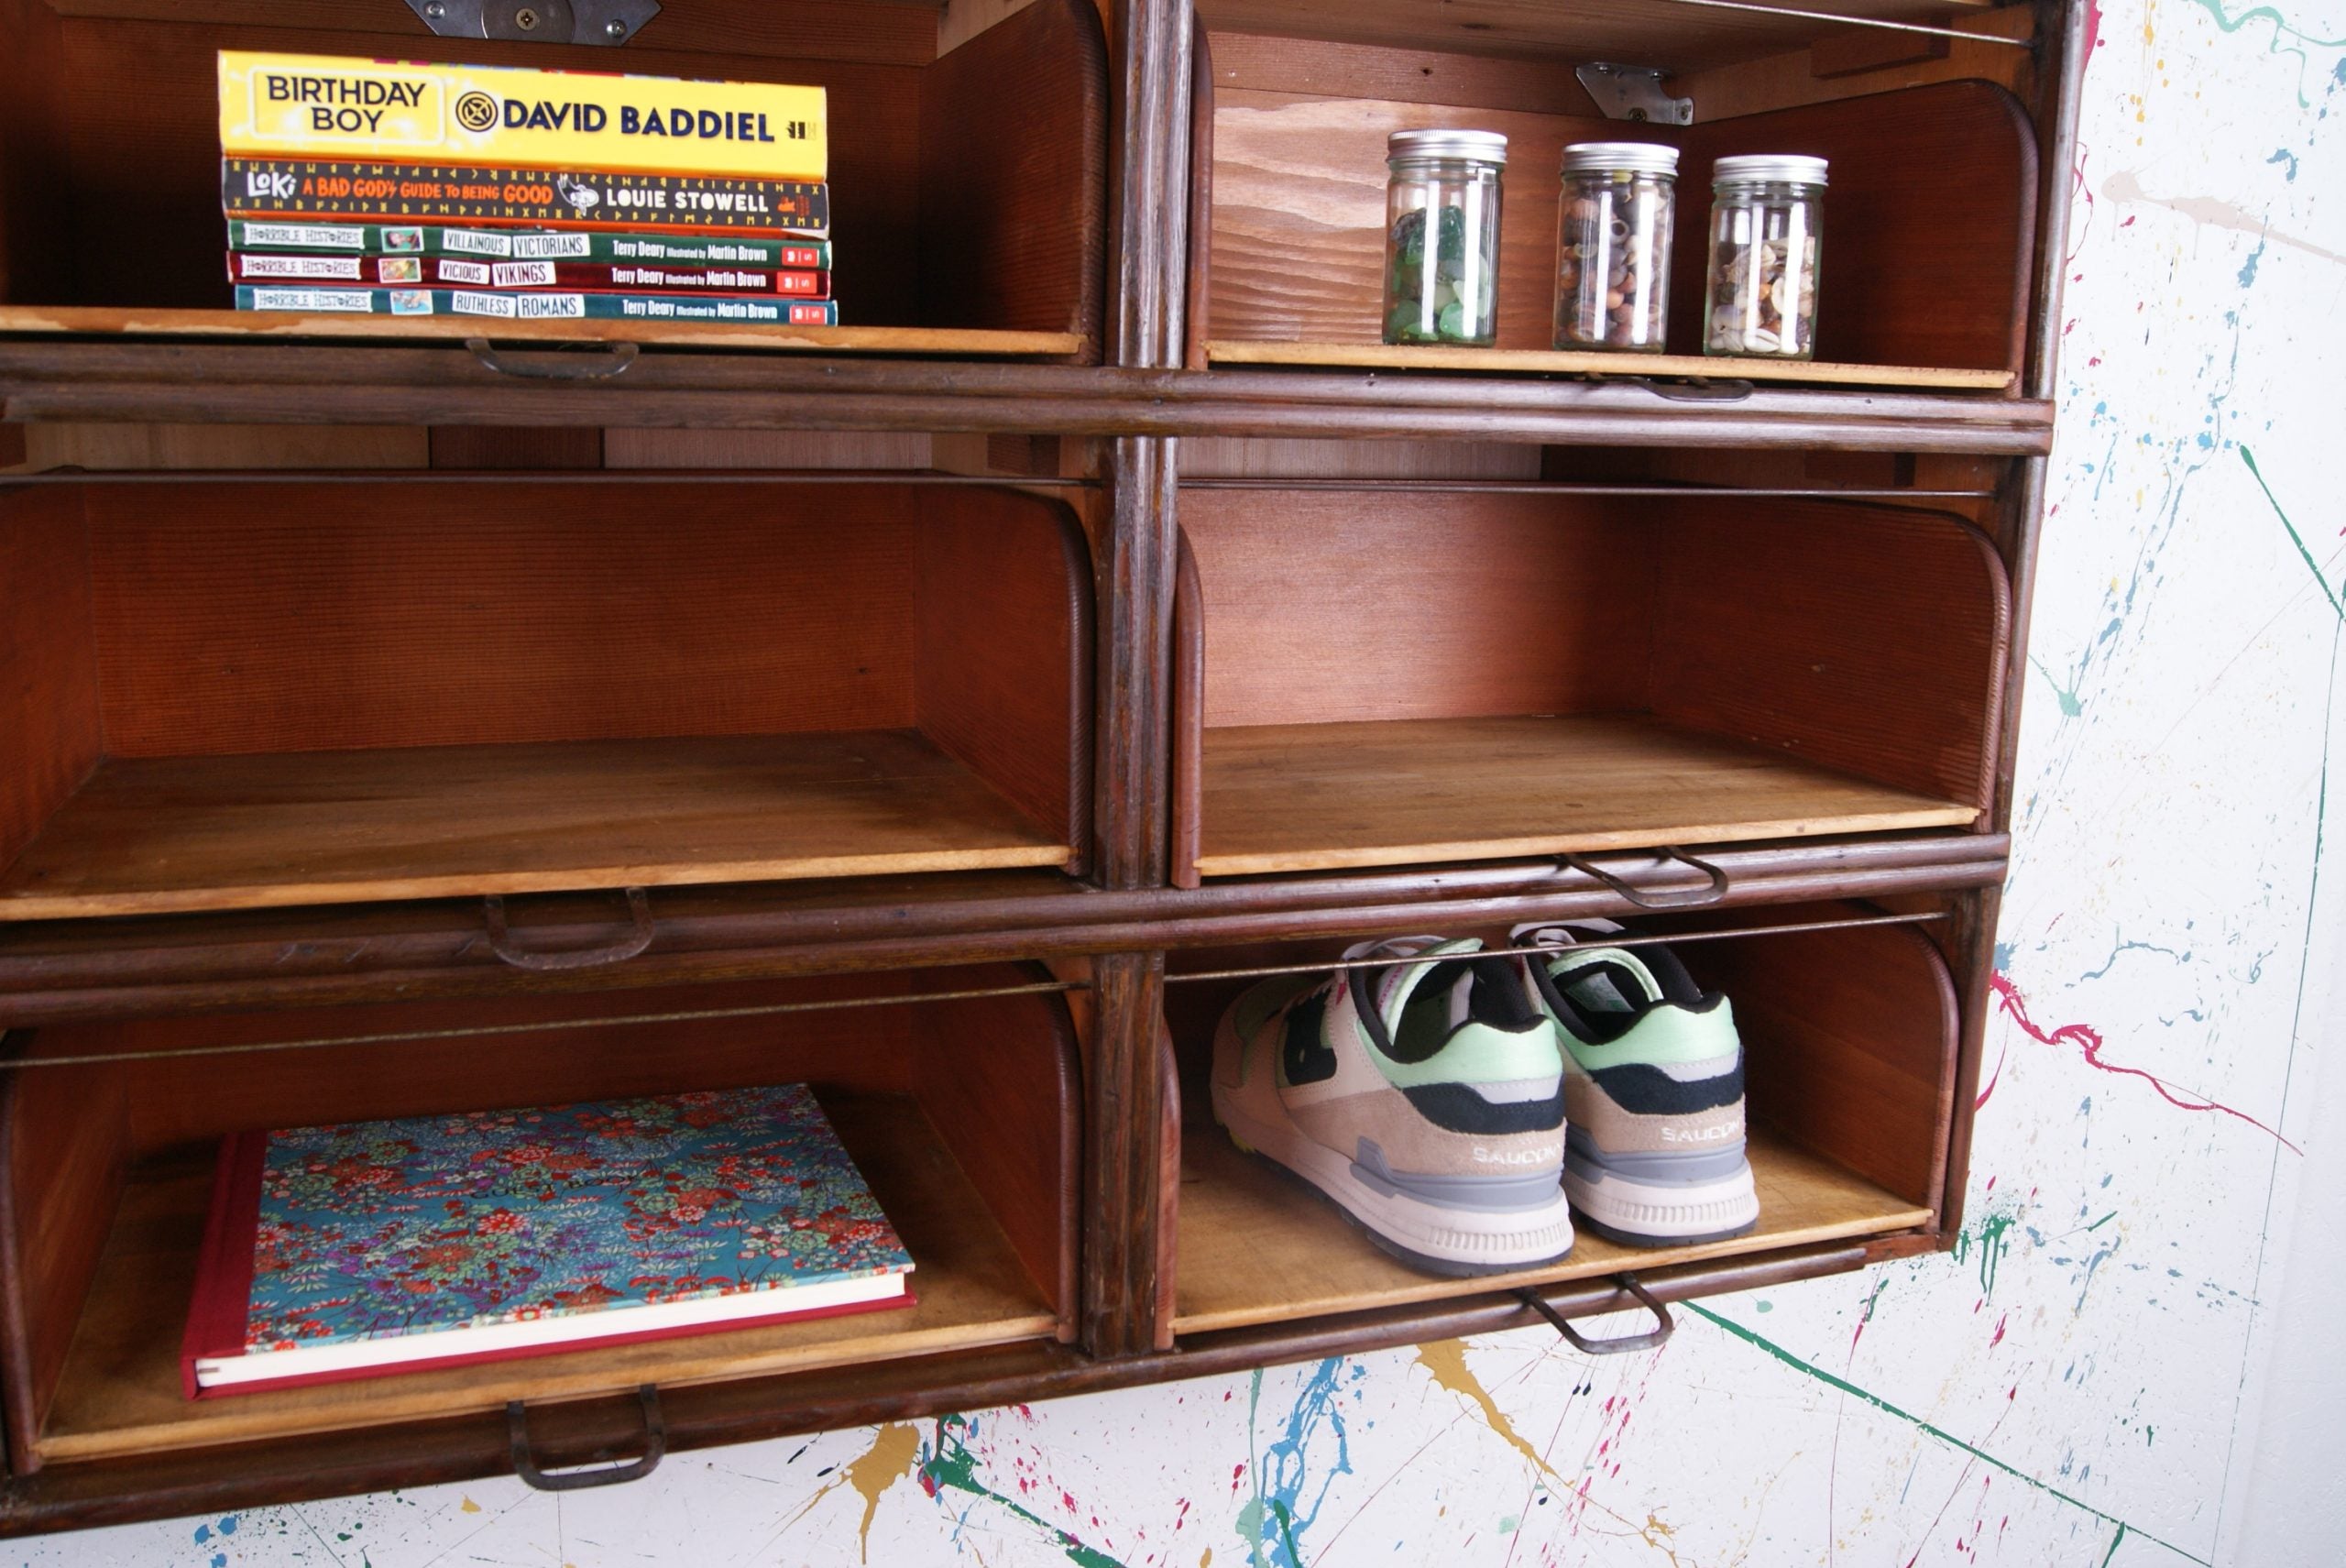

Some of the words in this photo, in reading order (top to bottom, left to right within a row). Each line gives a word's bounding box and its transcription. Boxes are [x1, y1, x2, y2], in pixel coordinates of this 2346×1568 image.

[266, 75, 426, 107] BIRTHDAY
[311, 106, 384, 133] BOY
[504, 99, 607, 133] DAVID
[620, 105, 775, 142] BADDIEL
[302, 178, 313, 195] A
[317, 177, 351, 198] BAD
[400, 181, 442, 199] GUIDE
[462, 184, 499, 200] BEING
[504, 184, 554, 204] GOOD
[607, 189, 667, 208] LOUIE
[674, 191, 769, 213] STOWELL
[249, 227, 301, 243] HORRIBLE
[306, 229, 360, 245] HISTORIES
[447, 231, 505, 253] VILLAINOUS
[516, 236, 584, 256] VICTORIANS
[613, 240, 637, 258] Terry
[638, 241, 665, 258] Deary
[707, 245, 737, 260] Martin
[738, 246, 768, 262] Brown
[246, 259, 298, 274] HORRIBLE
[302, 261, 356, 276] HISTORIES
[443, 263, 481, 280] VICIOUS
[496, 264, 546, 285] VIKINGS
[611, 268, 635, 284] Terry
[637, 268, 664, 285] Deary
[707, 271, 736, 286] Martin
[737, 271, 766, 287] Brown
[258, 292, 309, 307] HORRIBLE
[314, 294, 367, 309] HISTORIES
[457, 294, 509, 314] RUTHLESS
[521, 297, 577, 316] ROMANS
[622, 299, 646, 316] Terry
[648, 301, 674, 316] Deary
[718, 302, 747, 318] Martin
[748, 303, 777, 319] Brown
